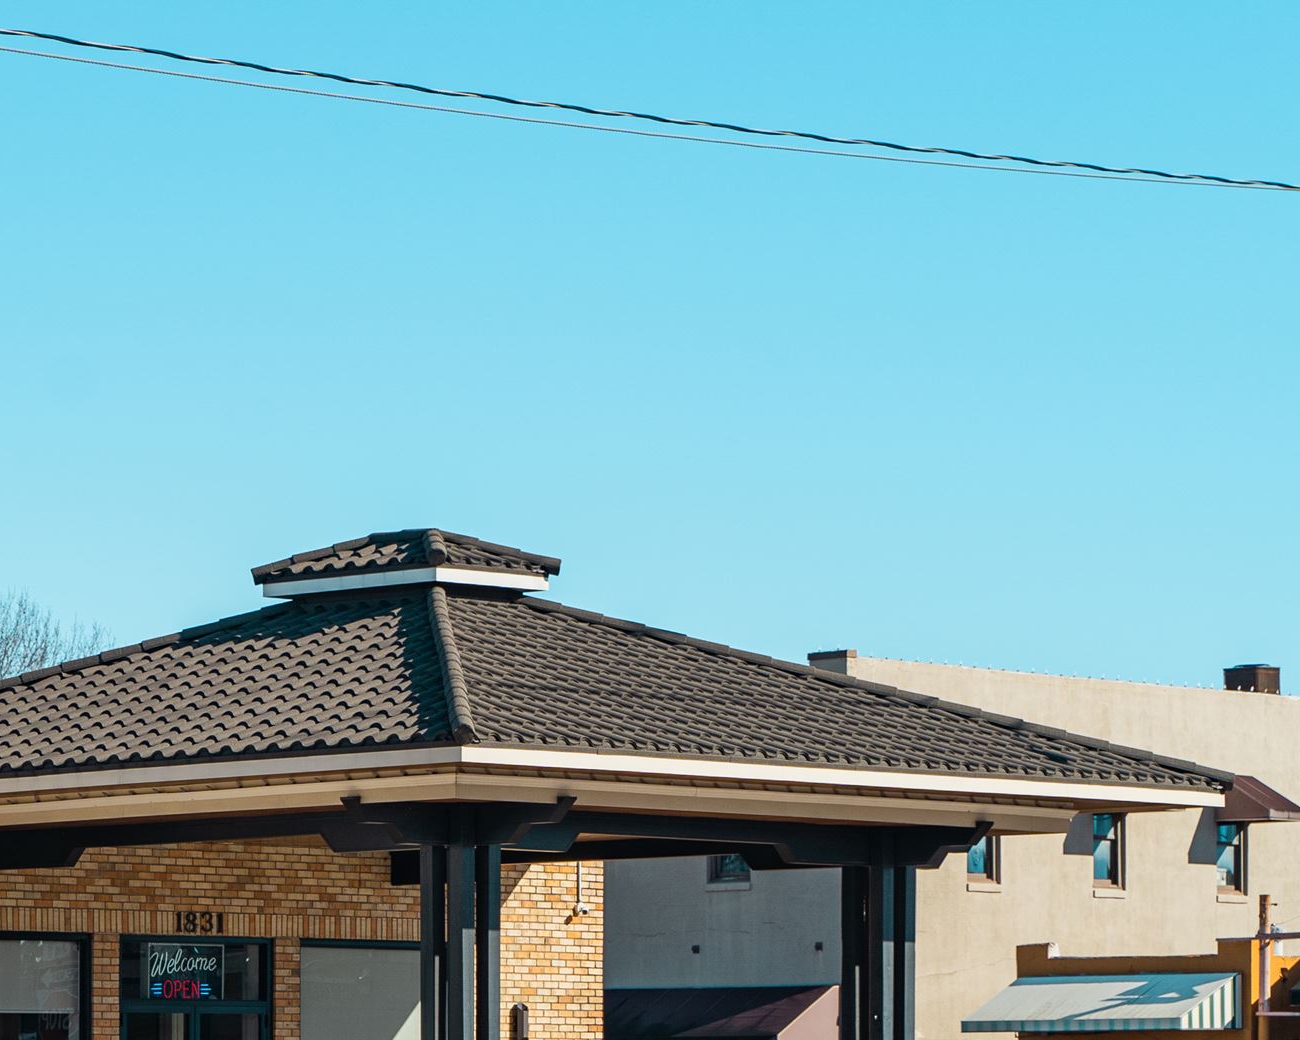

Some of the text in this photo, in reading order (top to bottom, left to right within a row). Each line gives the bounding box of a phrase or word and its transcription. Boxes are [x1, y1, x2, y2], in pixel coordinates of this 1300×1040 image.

[175, 912, 224, 933] 1831
[150, 949, 217, 977] Welcome
[162, 980, 200, 999] OPEN
